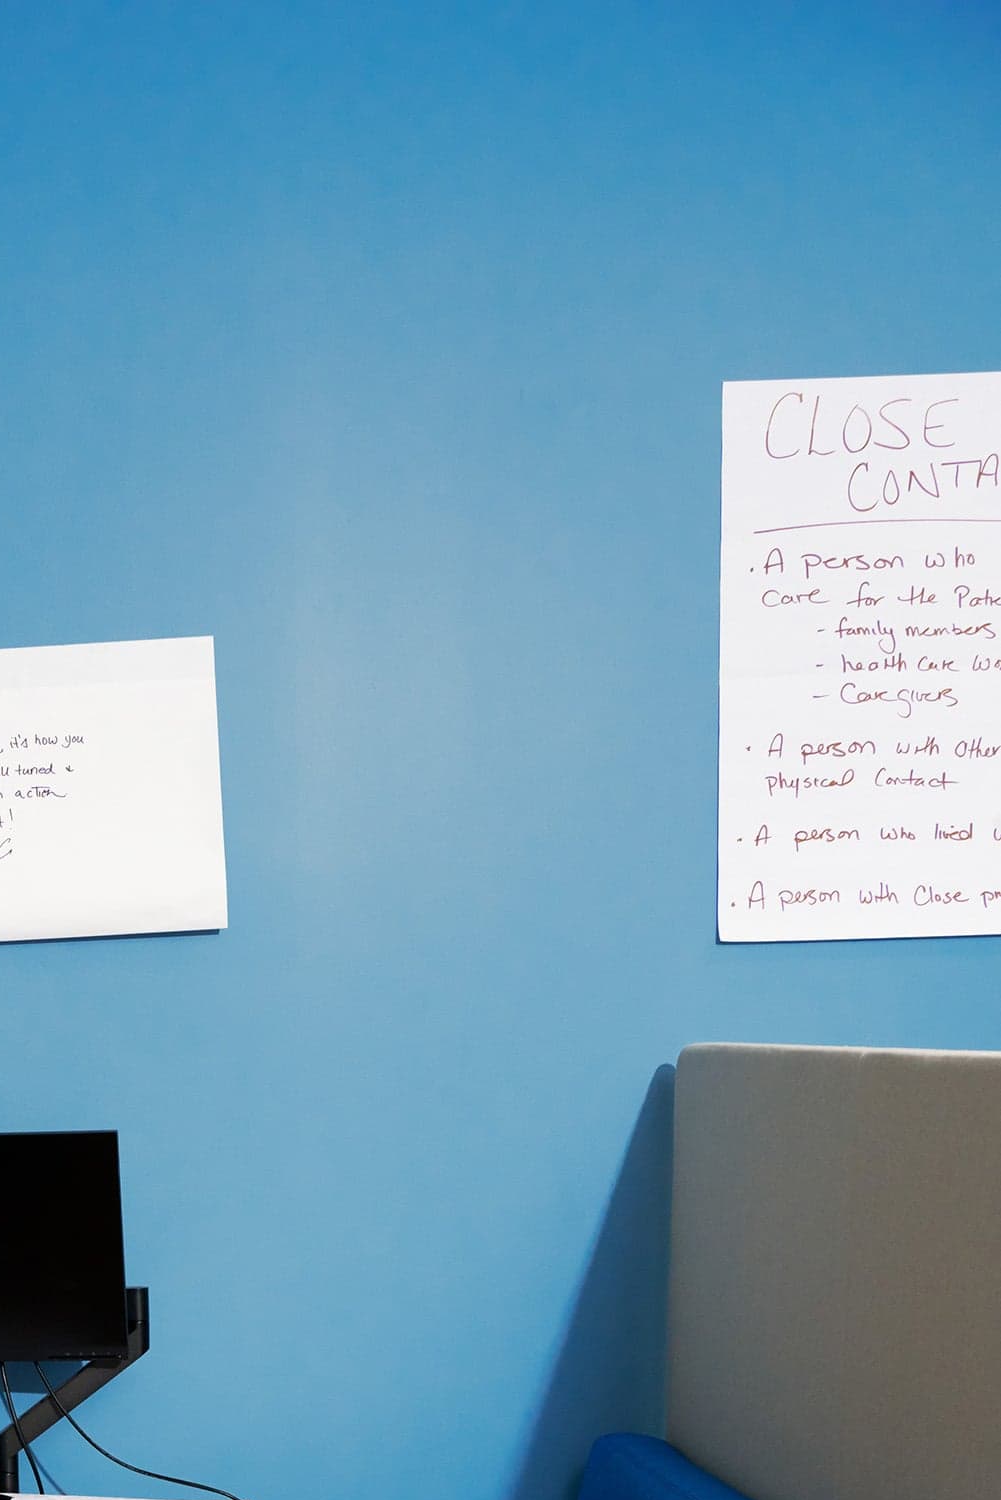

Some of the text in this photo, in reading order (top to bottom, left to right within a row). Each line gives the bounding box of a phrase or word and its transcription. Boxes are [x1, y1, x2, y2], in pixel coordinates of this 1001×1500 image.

[765, 392, 959, 459] CLOSE
[847, 453, 999, 512] CONTA
[763, 546, 976, 579] A person who
[845, 581, 885, 608] for
[897, 585, 936, 606] the
[834, 616, 997, 654] family members
[841, 654, 907, 673] health
[10, 734, 29, 749] it's
[34, 734, 59, 746] how
[61, 734, 85, 748] you
[767, 733, 784, 758] A
[800, 740, 877, 765] person
[896, 735, 941, 757] with
[15, 763, 56, 776] tuned
[765, 768, 856, 799] physical
[14, 786, 67, 799] action
[754, 824, 772, 847] A
[793, 829, 861, 853] person
[880, 826, 917, 842] who
[934, 822, 974, 842] lived
[747, 880, 765, 910] A
[778, 888, 841, 912] person
[858, 881, 900, 905] with
